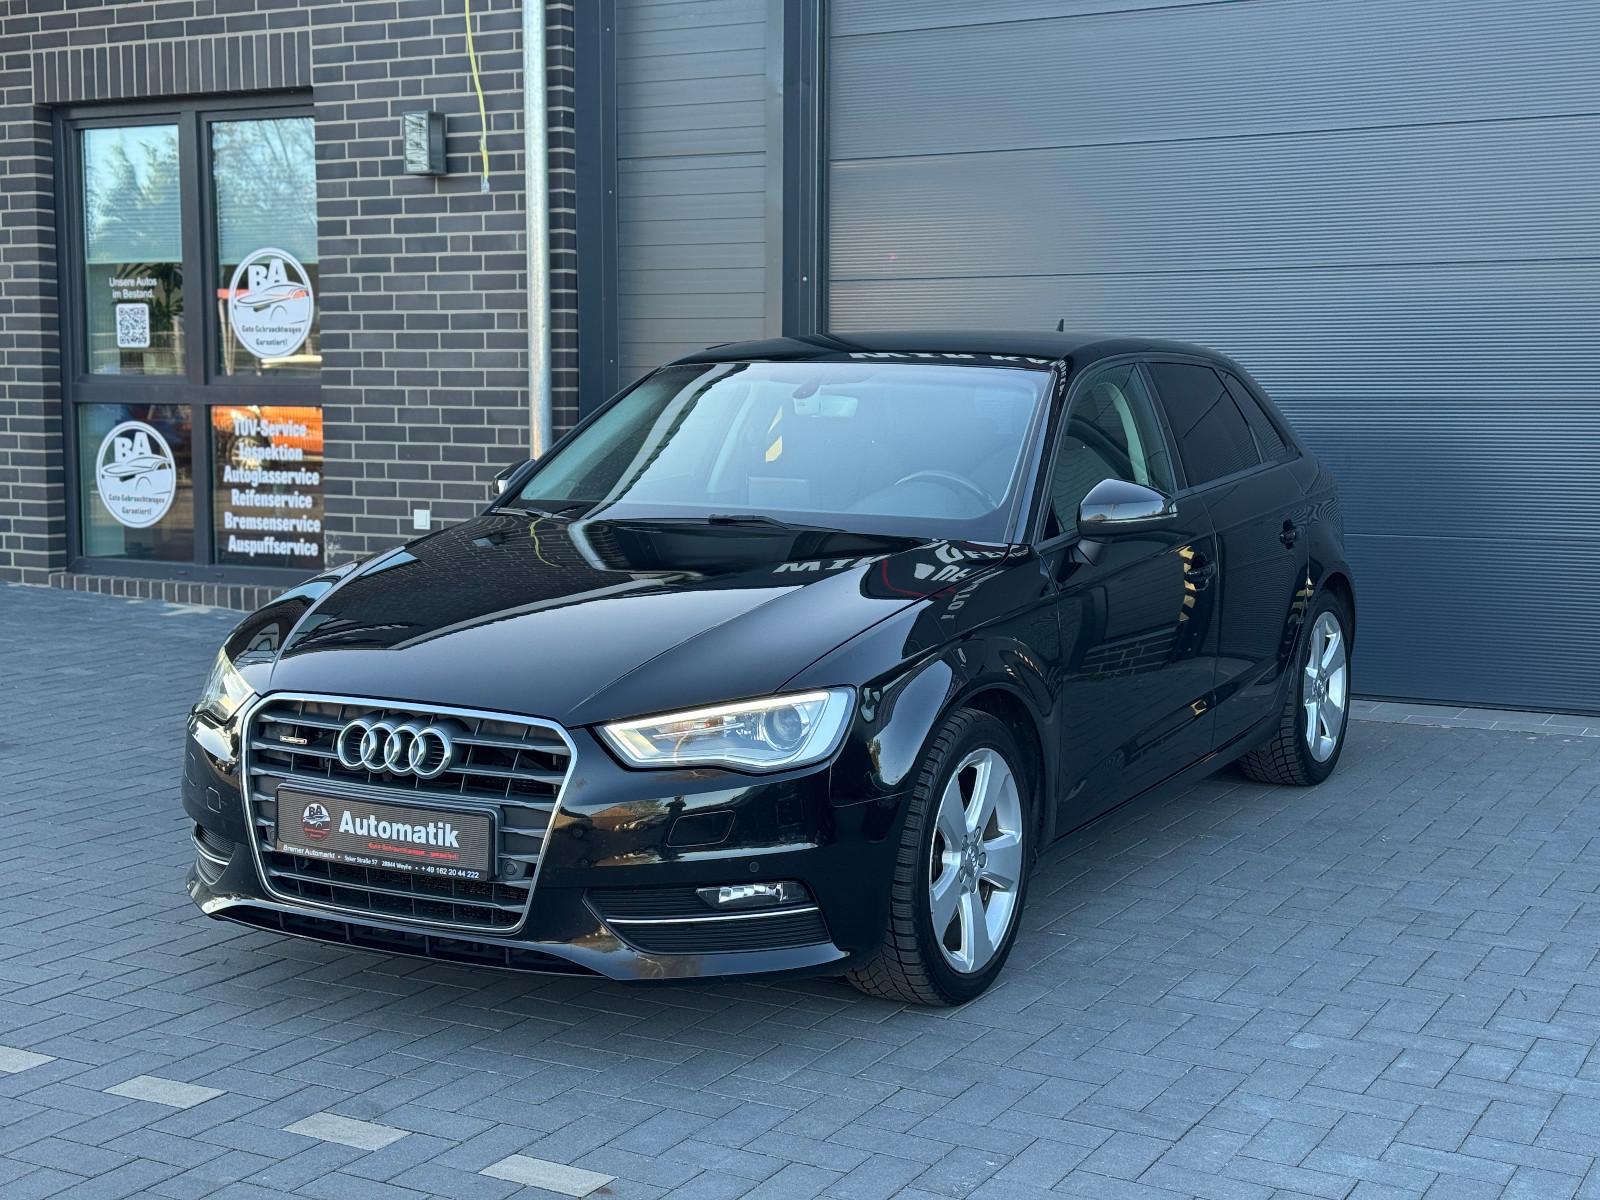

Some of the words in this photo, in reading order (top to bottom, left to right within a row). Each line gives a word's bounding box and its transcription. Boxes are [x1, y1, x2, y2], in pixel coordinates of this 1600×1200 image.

[109, 277, 135, 288] Unsere
[136, 276, 157, 287] Autos
[248, 259, 289, 288] BA
[112, 288, 121, 298] im
[114, 432, 152, 463] BA
[239, 443, 304, 463] Inspektion
[223, 465, 320, 487] Autoglasservice
[231, 489, 313, 509] Reifenservice
[224, 512, 321, 533] Bremsenservice
[228, 535, 319, 558] Auspuffservice
[338, 810, 460, 848] Automatik
[283, 844, 305, 854] Bremer
[305, 848, 336, 860] Automarkt
[448, 868, 457, 876] 20
[467, 871, 480, 879] 222
